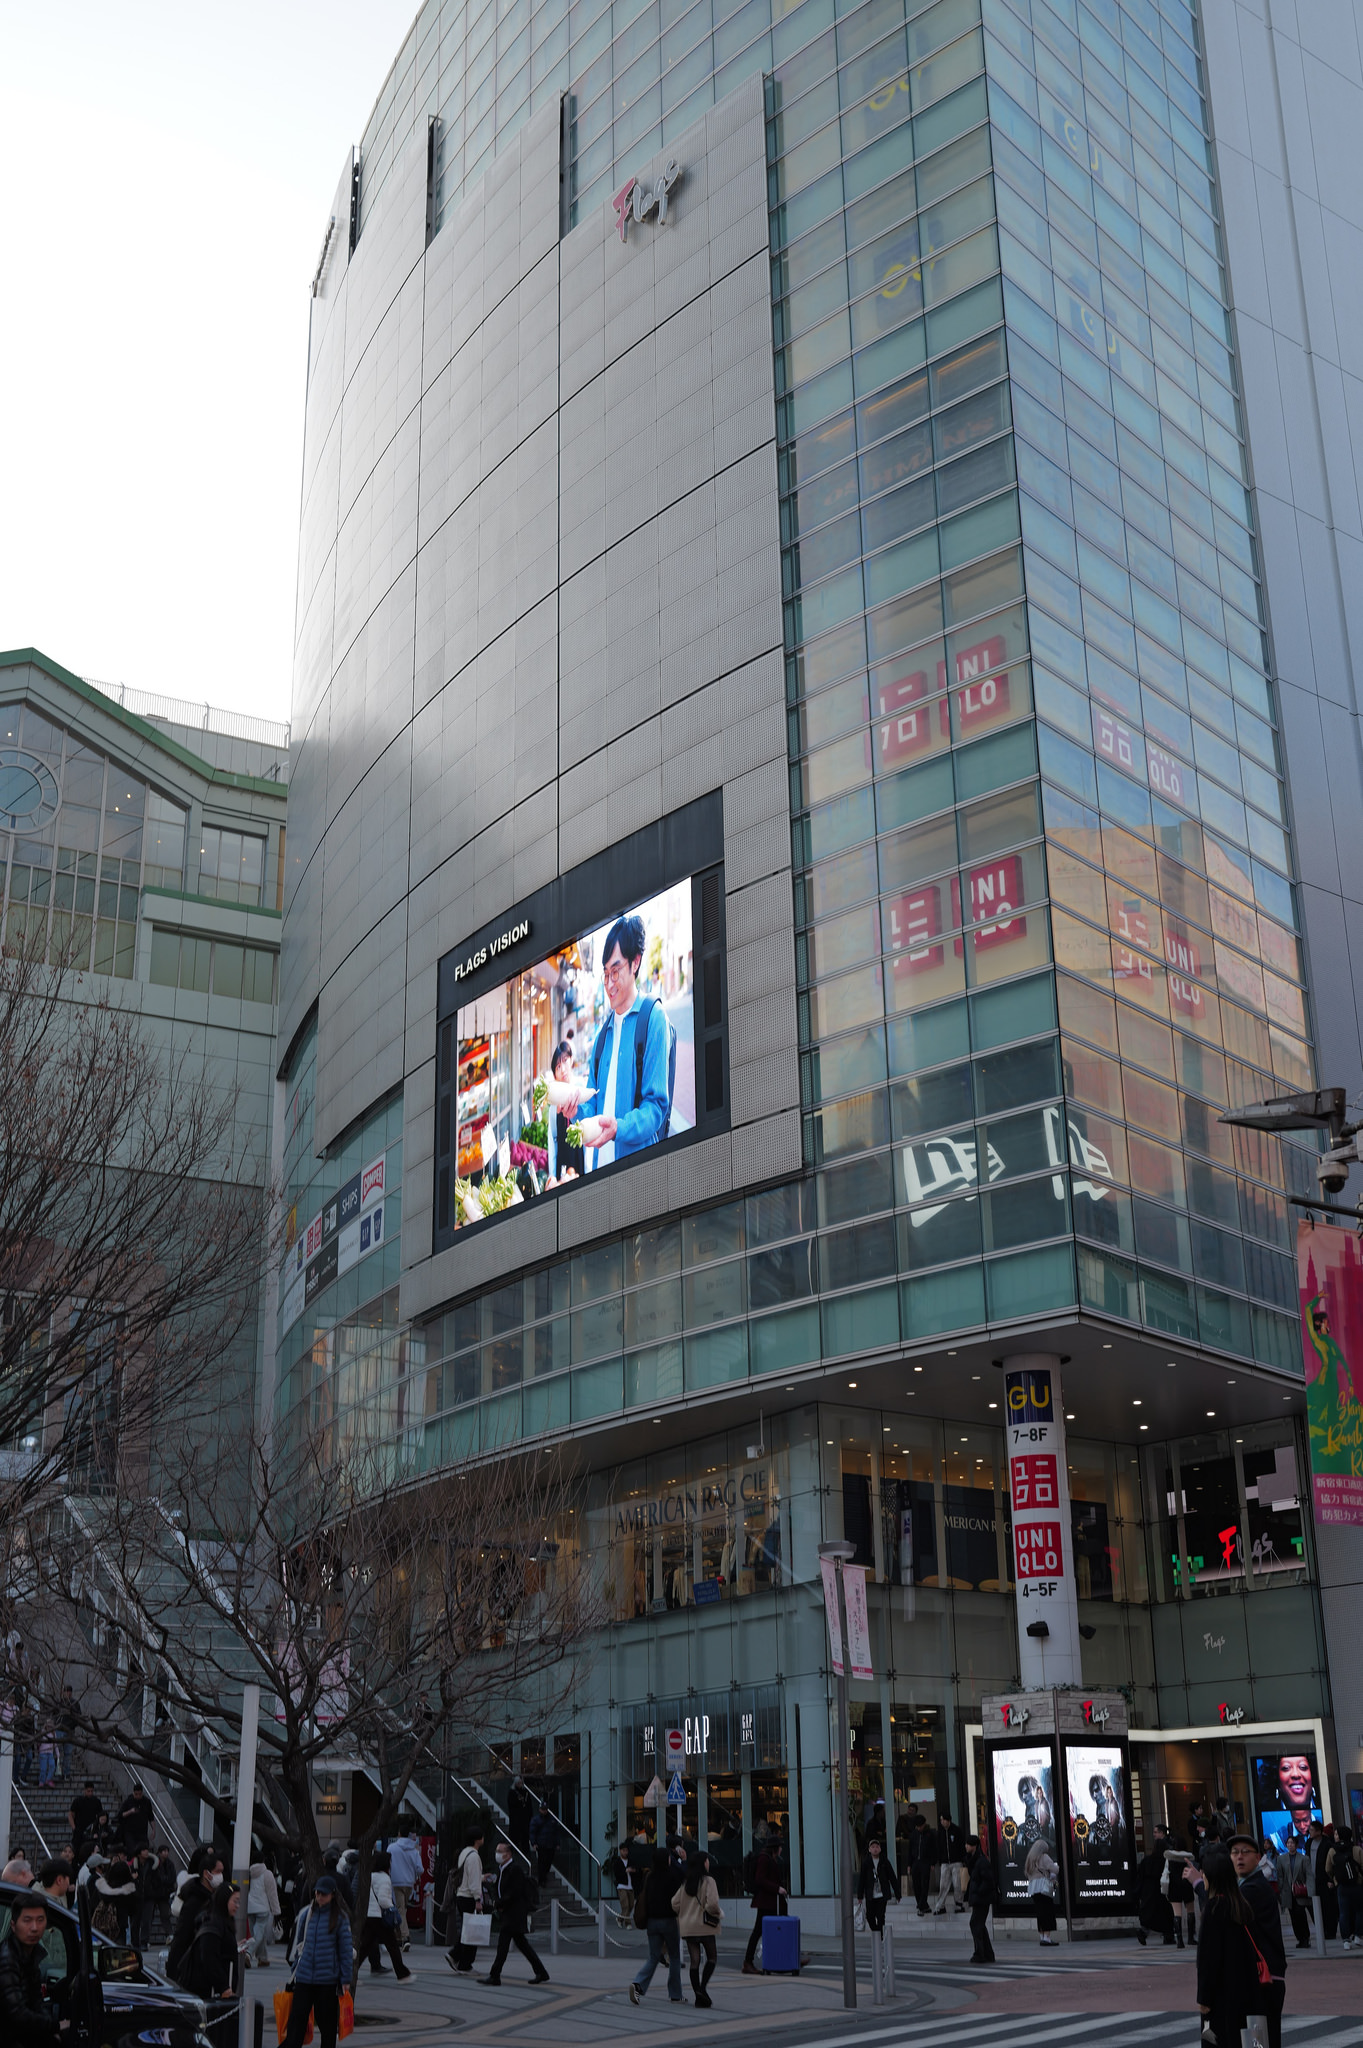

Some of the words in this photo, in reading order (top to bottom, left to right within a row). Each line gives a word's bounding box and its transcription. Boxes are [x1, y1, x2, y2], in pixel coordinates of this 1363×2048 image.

[612, 159, 680, 242] Flags
[1149, 759, 1180, 797] QLO
[454, 947, 487, 982] FLAGS
[489, 919, 529, 957] VISION
[1166, 936, 1196, 975] UNI
[341, 1188, 359, 1216] SHIPS
[1007, 1385, 1050, 1411] GU
[1012, 1427, 1049, 1444] 7-8F
[614, 1489, 698, 1538] AMERICAN
[702, 1479, 738, 1514] RAG
[740, 1470, 767, 1502] CIE
[1321, 1493, 1340, 1505] 協力
[943, 1514, 990, 1533] MERICAN
[991, 1519, 1011, 1535] RG
[1017, 1528, 1053, 1549] UNI
[1018, 1550, 1058, 1576] QLO
[1022, 1581, 1058, 1599] 4-5F
[1202, 1632, 1226, 1655] Flags
[1000, 1703, 1029, 1733] Flags
[1082, 1700, 1111, 1732] Flags
[1217, 1703, 1244, 1728] Flags
[685, 1715, 710, 1756] GAP
